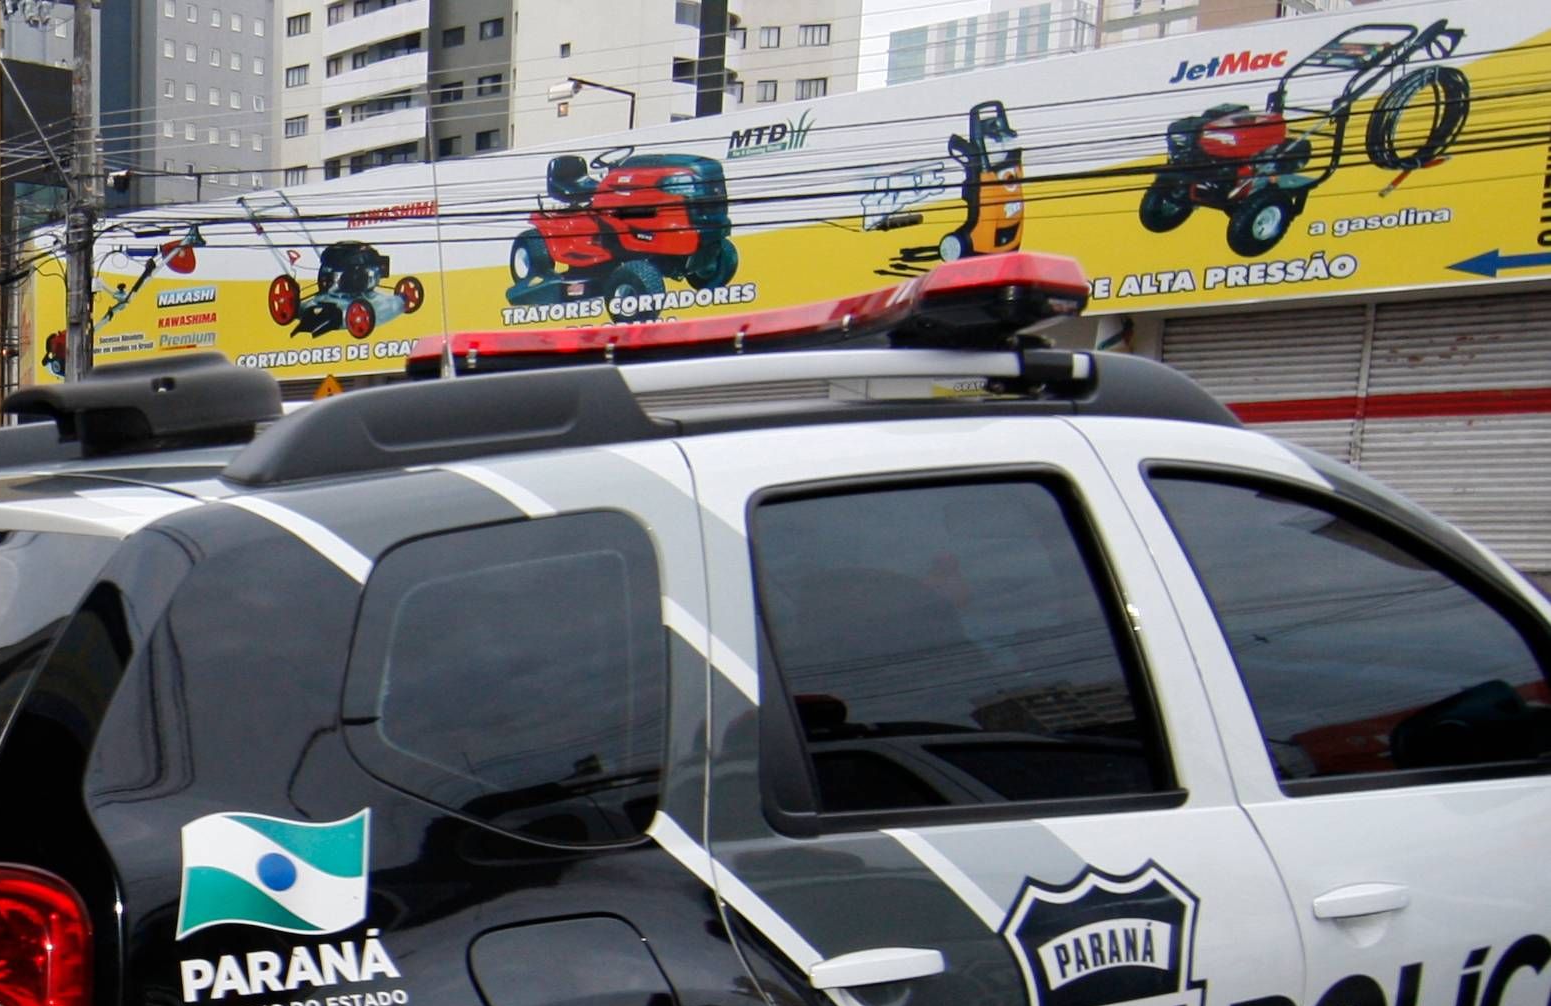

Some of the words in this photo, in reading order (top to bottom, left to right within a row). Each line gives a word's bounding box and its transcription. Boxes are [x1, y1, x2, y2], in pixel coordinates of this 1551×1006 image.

[1169, 50, 1288, 84] JetMac
[729, 123, 787, 149] MTD
[1308, 220, 1325, 236] a
[1332, 207, 1451, 237] gasolina
[1117, 270, 1196, 299] ALTA
[1204, 251, 1358, 290] PRESSÃO
[158, 288, 215, 307] NAKASHI
[502, 298, 604, 325] TRATORES
[609, 283, 757, 317] CORTADORES
[158, 312, 217, 329] KAWASHIMA
[159, 332, 216, 346] Premium
[236, 346, 341, 369] CORTADORES
[346, 343, 370, 360] DE
[374, 339, 418, 357] GRA
[1053, 921, 1155, 979] PARANÁ
[180, 928, 401, 1003] PARANÁ
